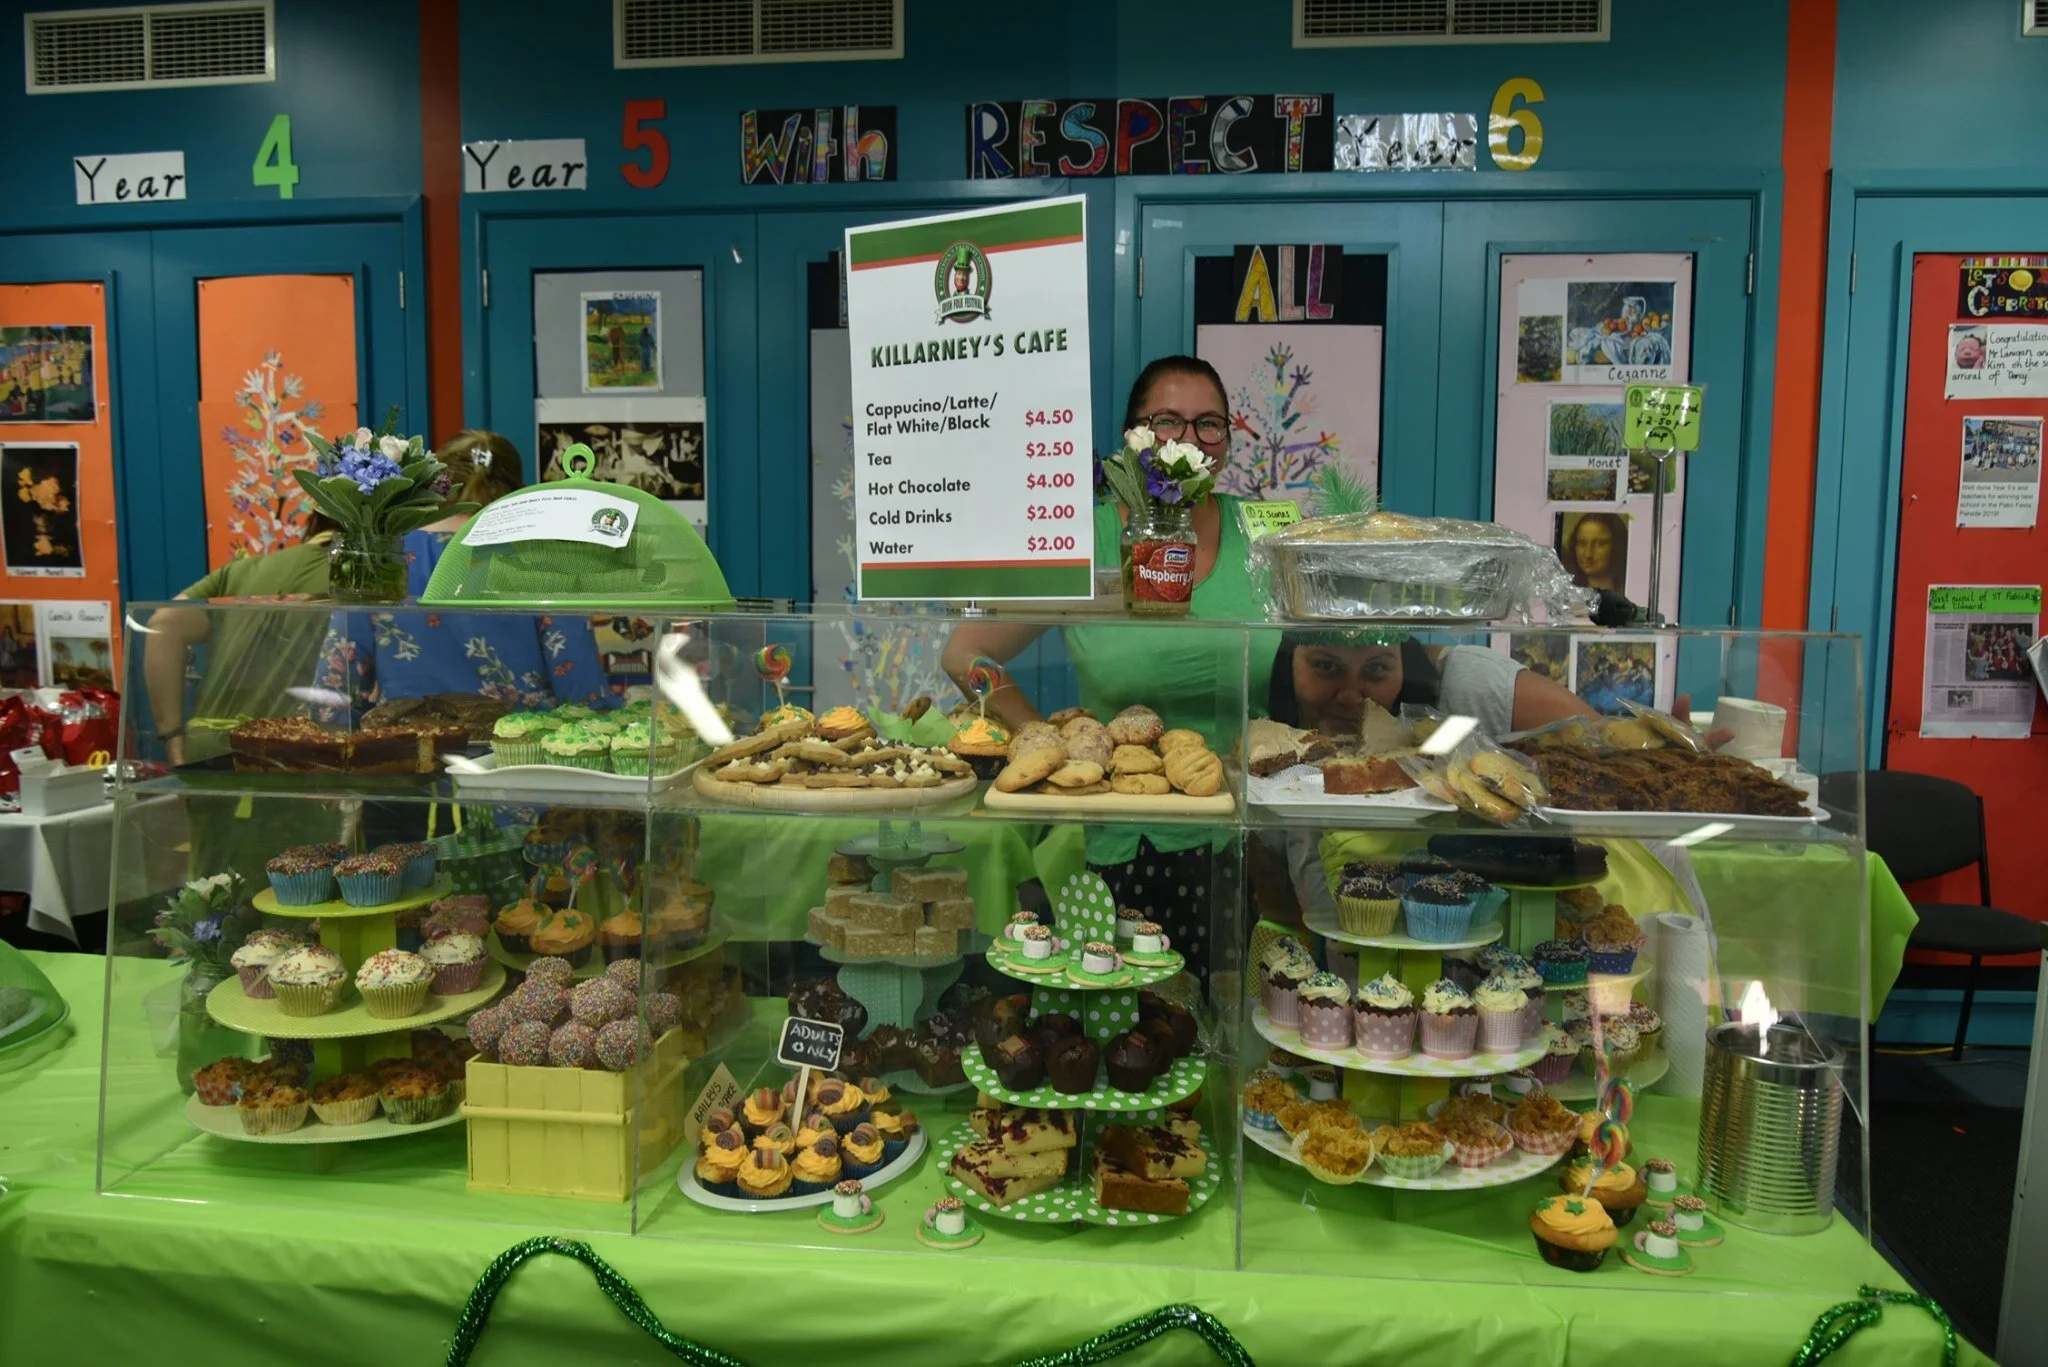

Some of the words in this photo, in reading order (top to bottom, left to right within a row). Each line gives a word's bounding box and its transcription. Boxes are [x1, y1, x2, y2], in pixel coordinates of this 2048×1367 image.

[1338, 117, 1474, 166] Year
[1488, 77, 1545, 171] 6
[466, 144, 584, 190] Year
[620, 98, 670, 188] 5
[741, 104, 888, 184] With
[971, 94, 1322, 179] RESPECT
[76, 157, 184, 201] Year
[253, 114, 298, 199] 4
[1235, 243, 1334, 322] ALL
[871, 333, 1004, 368] KILLARNEY'S
[1014, 328, 1068, 354] CAFE
[1608, 367, 1667, 382] Cezanne
[2025, 358, 2039, 370] the
[1952, 371, 1981, 380] arrival
[1989, 370, 2000, 385] of
[866, 392, 998, 419] Cappucino/Latte/
[867, 422, 892, 436] Flat
[897, 414, 990, 434] White/Black
[1025, 409, 1073, 427] $4.50
[867, 453, 892, 466] Tea
[1026, 441, 1074, 459] $2.50
[1588, 456, 1622, 468] Monet
[868, 482, 893, 496] Hot
[898, 478, 971, 494] Chocolate
[1026, 473, 1075, 490] $4.00
[869, 510, 900, 525] Cold
[905, 508, 952, 524] Drinks
[1027, 505, 1075, 521] $2.00
[869, 541, 914, 555] Water
[1027, 536, 1075, 553] $2.00
[1139, 564, 1188, 587] Raspberry
[1979, 591, 1988, 601] of
[790, 1023, 842, 1046] ADULTS
[791, 1041, 837, 1063] ONLY
